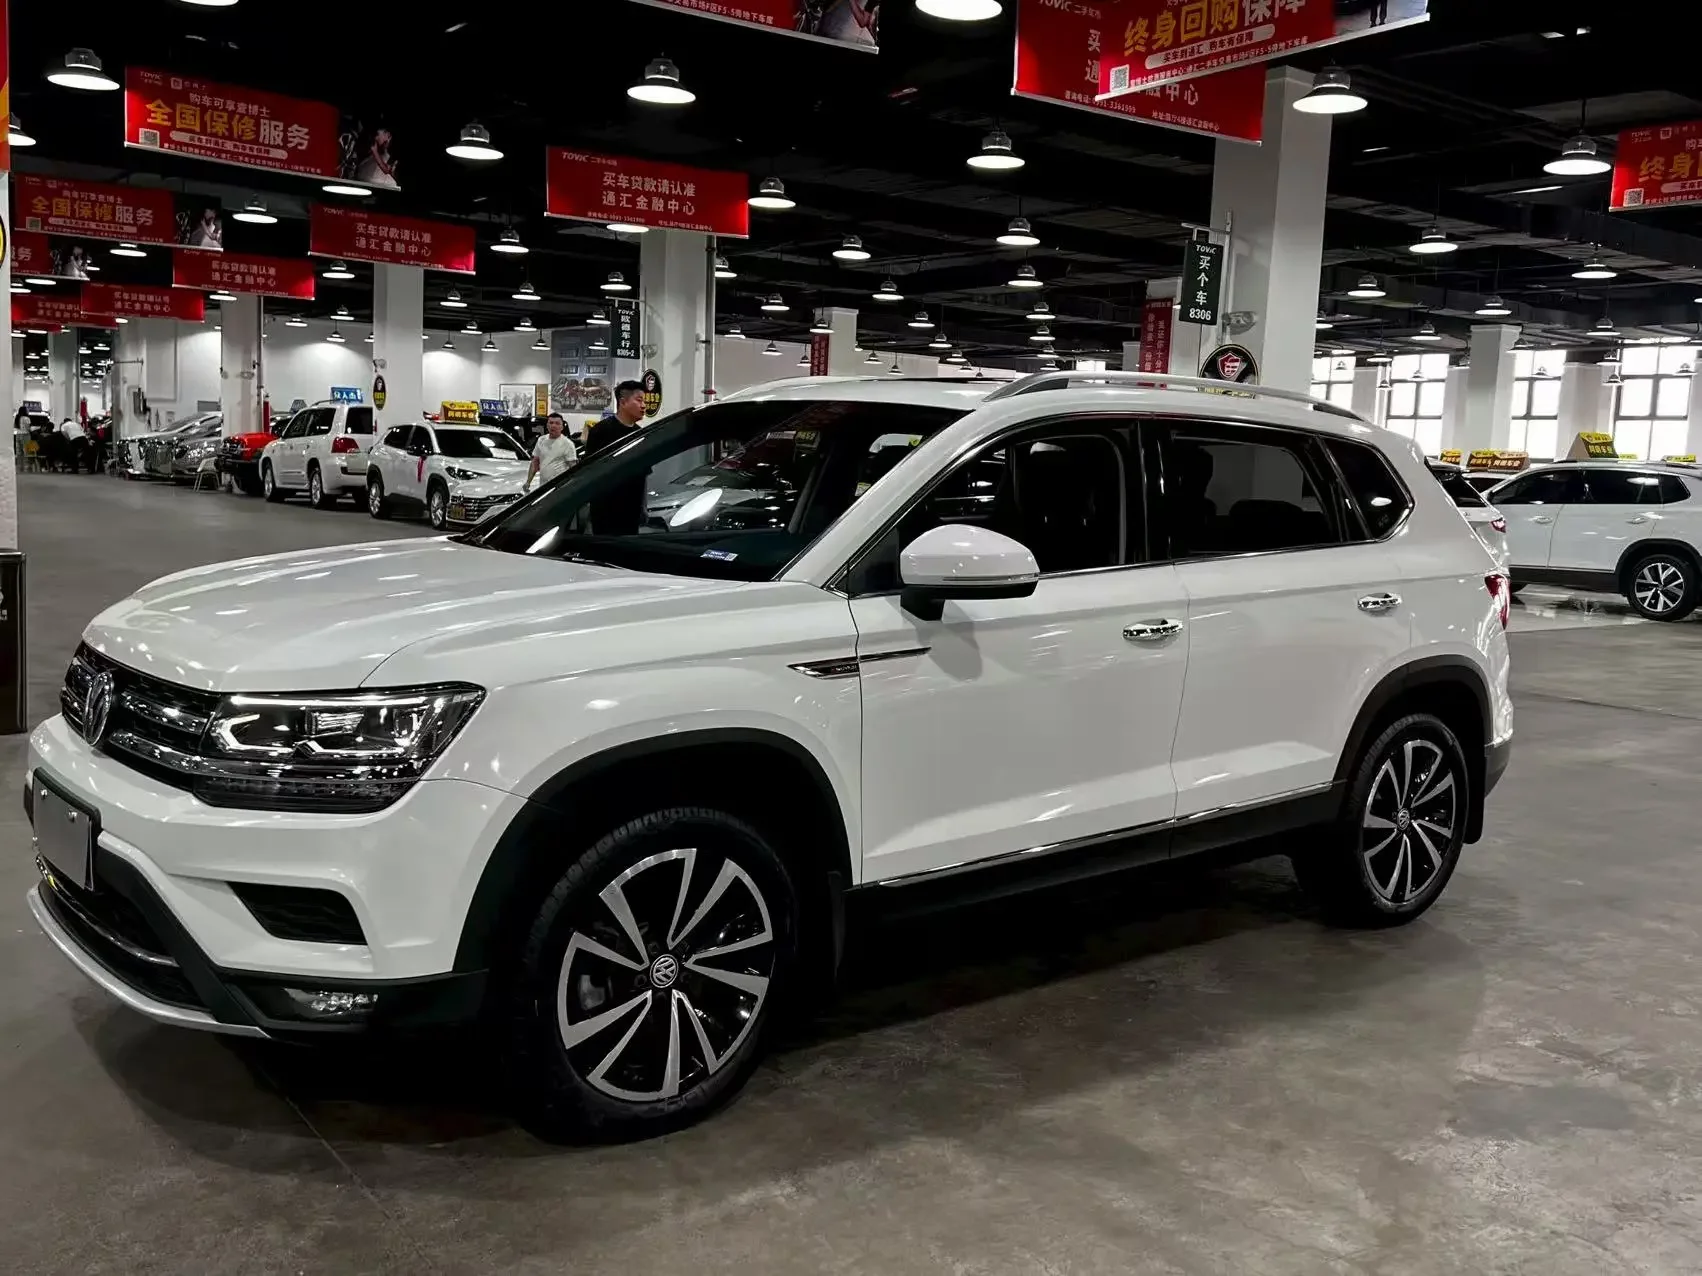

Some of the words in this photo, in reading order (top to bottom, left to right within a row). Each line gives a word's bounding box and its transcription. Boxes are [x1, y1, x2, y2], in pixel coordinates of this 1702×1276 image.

[146, 99, 310, 150] 全国保修服务
[562, 151, 589, 163] TOVIC
[1638, 151, 1702, 182] 终身
[602, 171, 696, 197] 买车贷款请认准
[31, 195, 154, 226] 全国保修服务
[602, 191, 696, 216] 通汇金融中心
[355, 222, 432, 244] 买车贷款请认准
[355, 236, 431, 257] 通汇金融中心
[1196, 244, 1217, 255] TOVIC
[1195, 255, 1211, 306] 买个车
[1189, 307, 1212, 321] 8306
